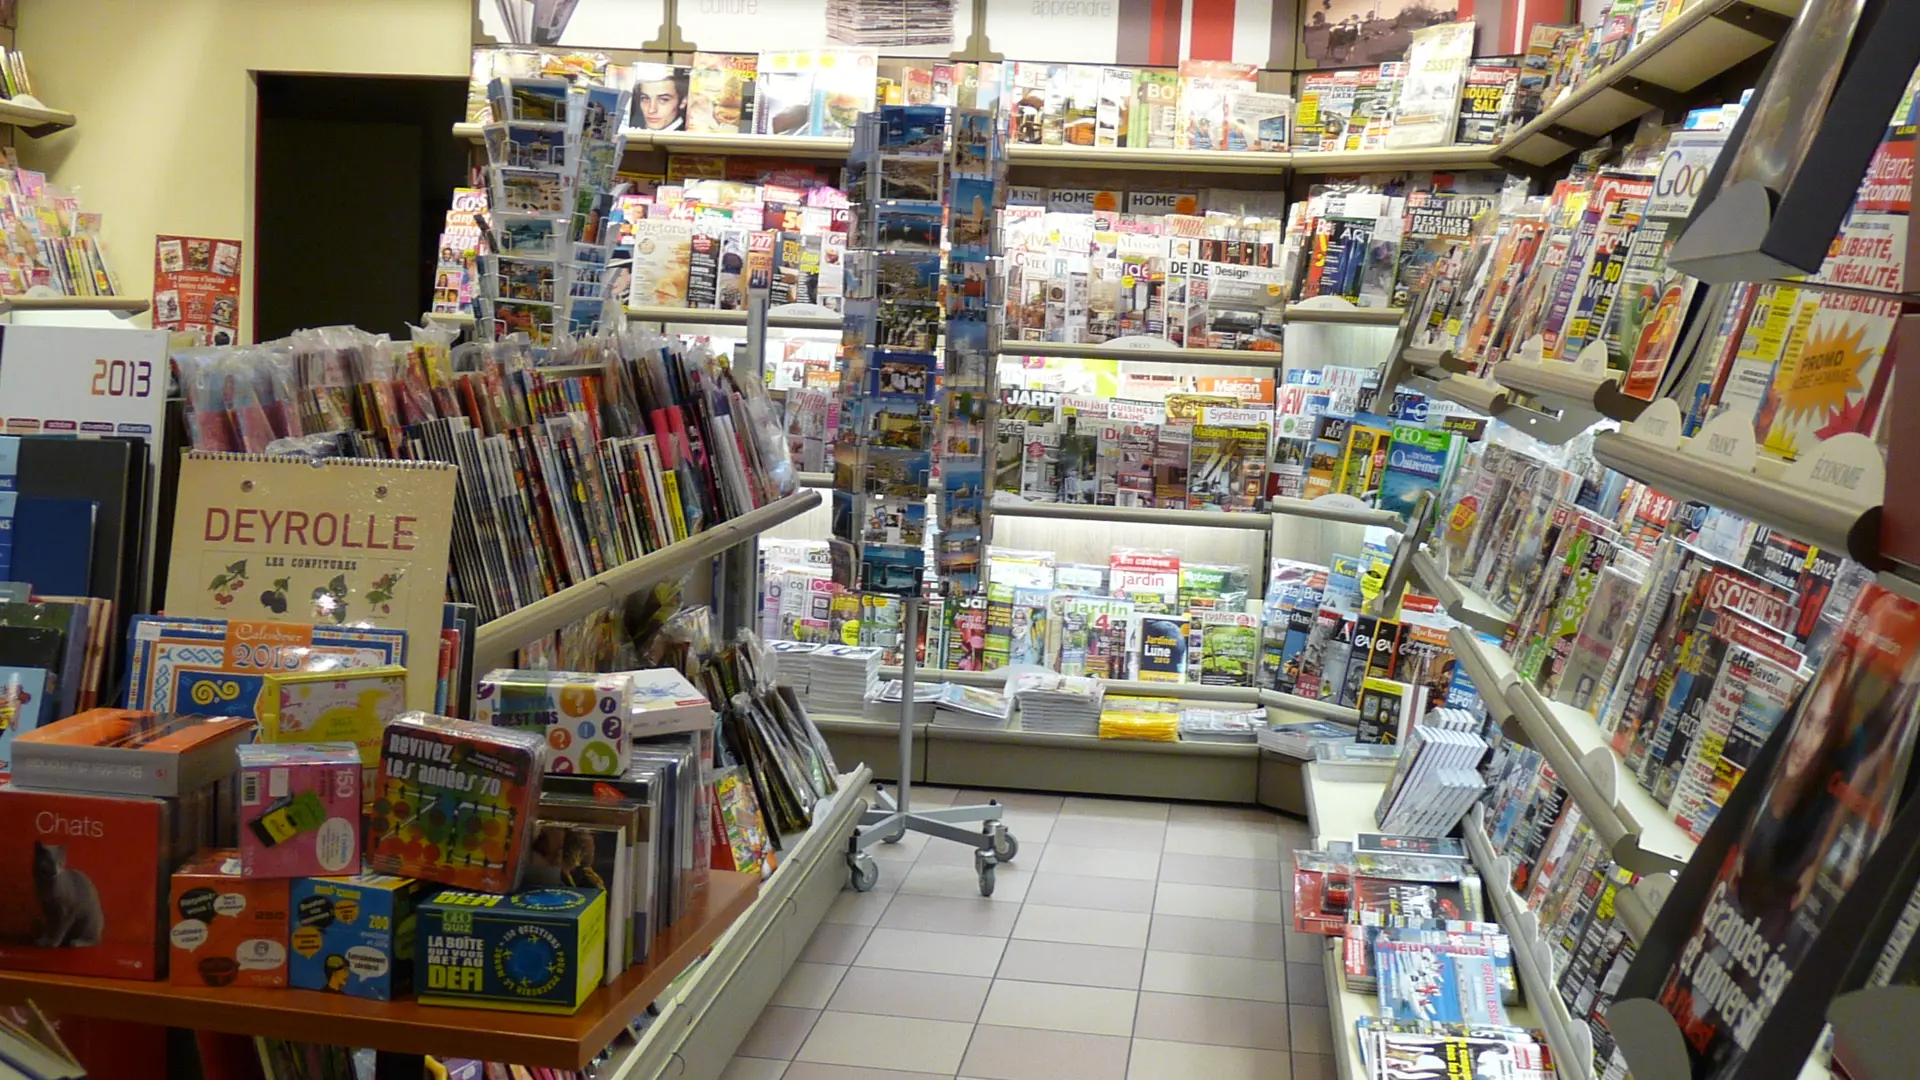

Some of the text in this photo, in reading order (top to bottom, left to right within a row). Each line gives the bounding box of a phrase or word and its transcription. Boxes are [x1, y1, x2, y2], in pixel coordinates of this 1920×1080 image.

[1052, 190, 1095, 205] HOME
[1132, 194, 1177, 207] HOME
[91, 359, 152, 398] 2013
[1392, 427, 1422, 444] GEO
[204, 507, 417, 551] DEYROLLE
[1121, 572, 1165, 588] jardin
[1144, 643, 1171, 657] Lune
[34, 810, 105, 839] Chats
[428, 936, 443, 948] LA
